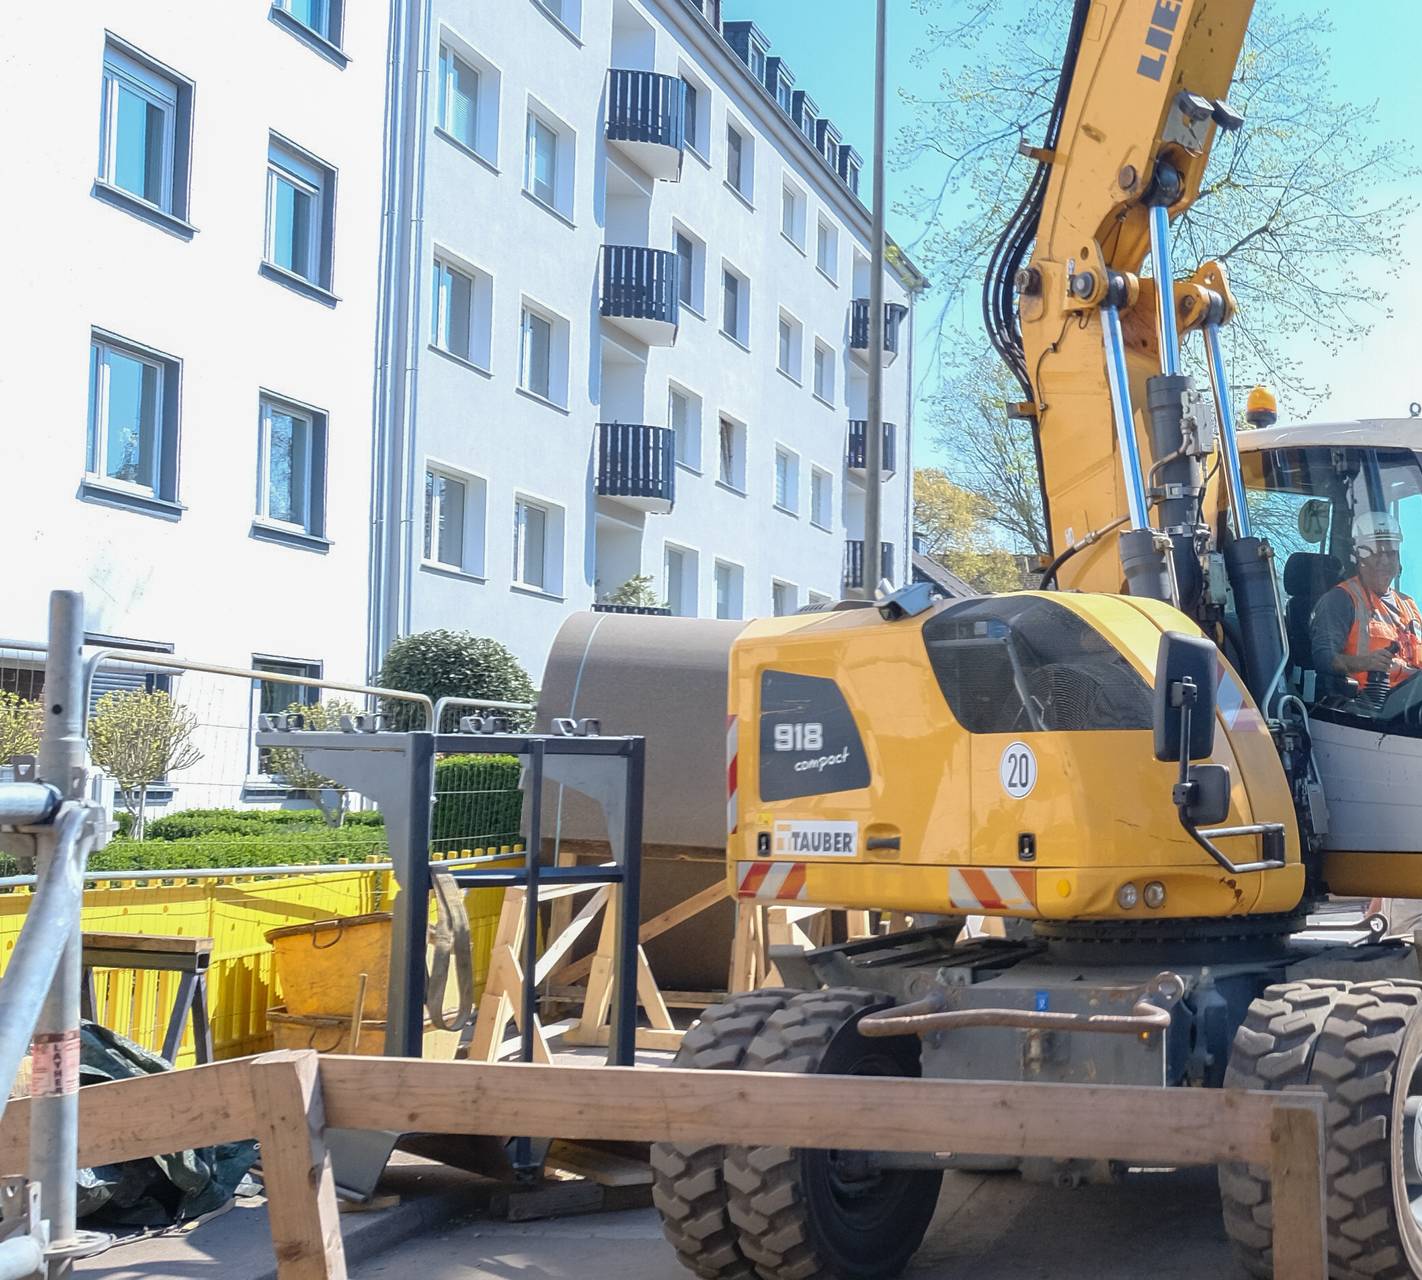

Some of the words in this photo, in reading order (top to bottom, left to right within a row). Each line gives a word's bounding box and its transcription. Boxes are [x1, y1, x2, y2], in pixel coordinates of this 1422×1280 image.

[1136, 0, 1182, 81] LIE
[774, 723, 823, 751] 918
[794, 746, 849, 771] compact
[1008, 753, 1028, 788] 20
[792, 831, 853, 852] TAUBER
